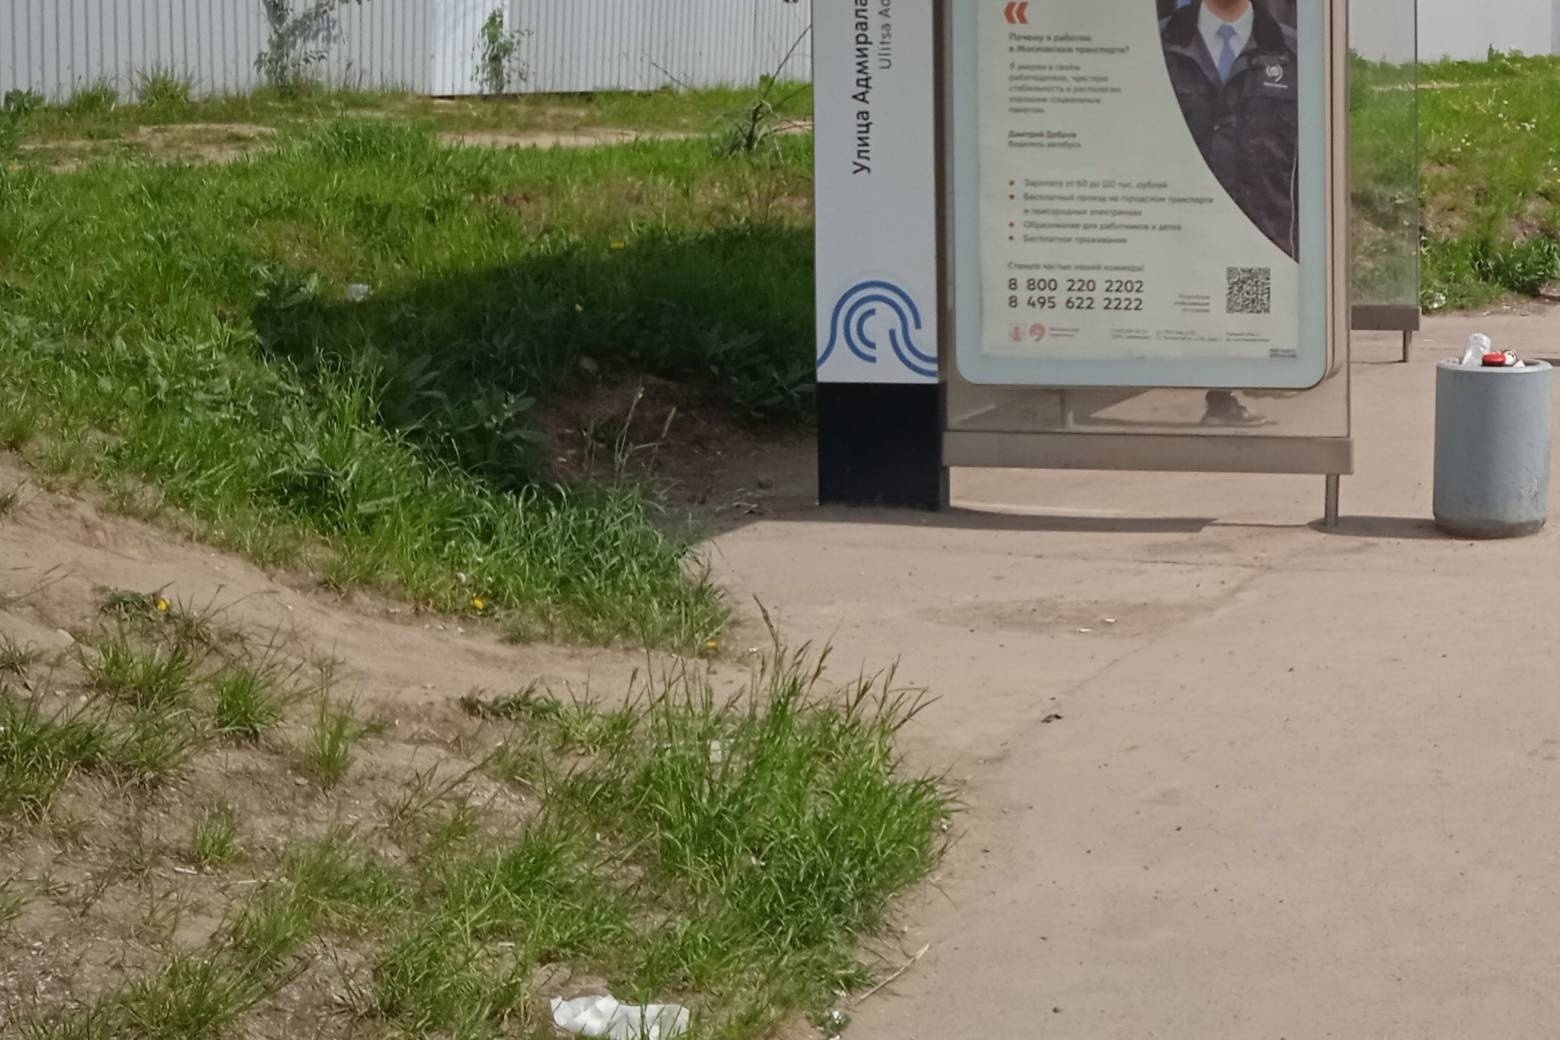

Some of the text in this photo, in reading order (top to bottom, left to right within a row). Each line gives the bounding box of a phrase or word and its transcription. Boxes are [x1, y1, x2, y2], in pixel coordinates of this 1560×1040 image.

[879, 25, 892, 70] Ulitsa
[852, 110, 871, 174] Улица
[1008, 278, 1144, 293] 8 800 220 2202
[1008, 296, 1143, 311] 8 495 622 2222
